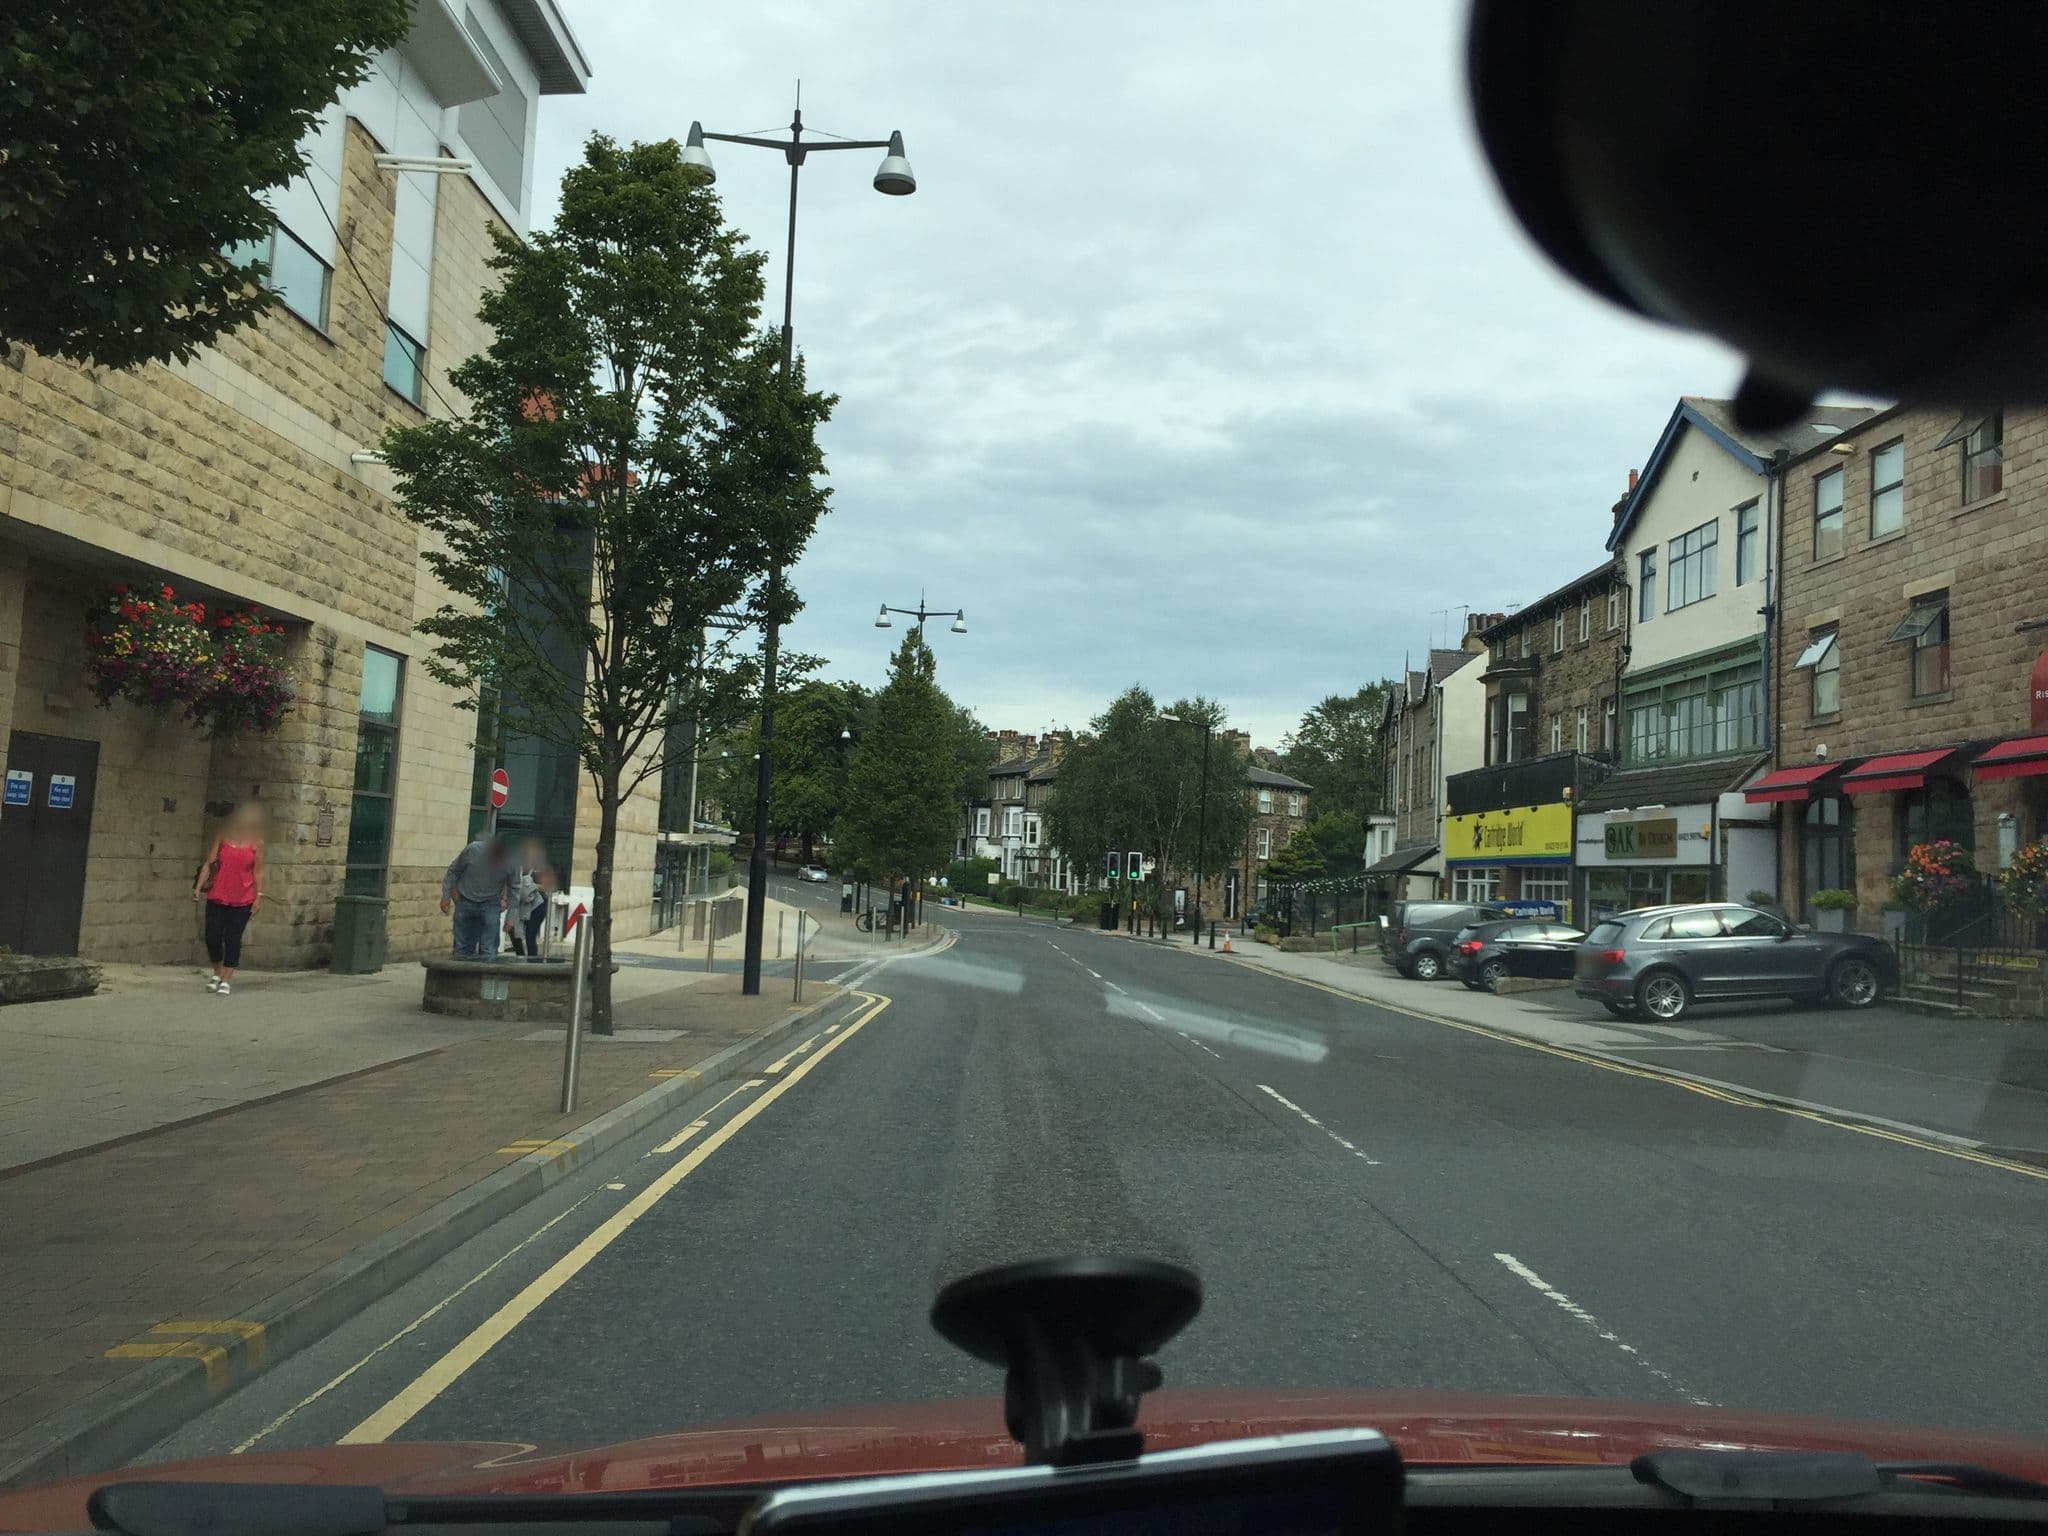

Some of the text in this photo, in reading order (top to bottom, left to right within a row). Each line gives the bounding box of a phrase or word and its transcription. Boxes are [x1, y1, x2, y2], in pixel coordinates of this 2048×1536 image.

[1484, 820, 1524, 852] Cartridge World
[1605, 825, 1635, 853] OAK
